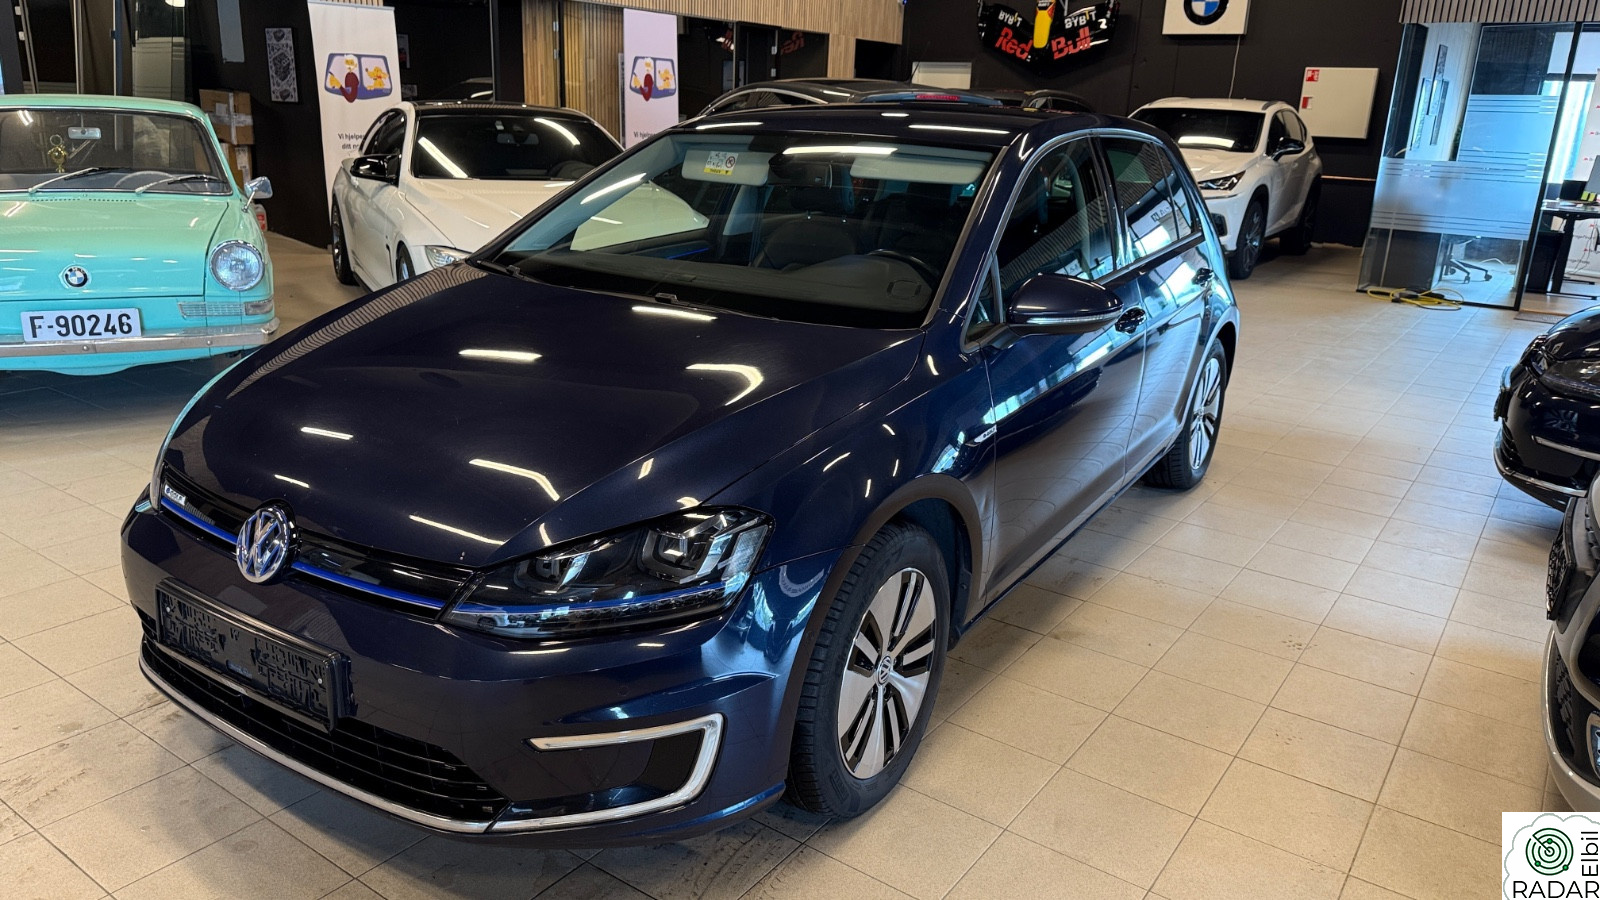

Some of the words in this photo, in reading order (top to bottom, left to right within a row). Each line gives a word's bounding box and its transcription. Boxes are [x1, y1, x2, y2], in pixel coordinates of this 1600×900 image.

[998, 9, 1023, 28] BYBIT
[1064, 9, 1097, 29] BYBIT
[995, 26, 1033, 60] Red
[1051, 26, 1092, 60] Bull
[29, 313, 133, 339] F-90246
